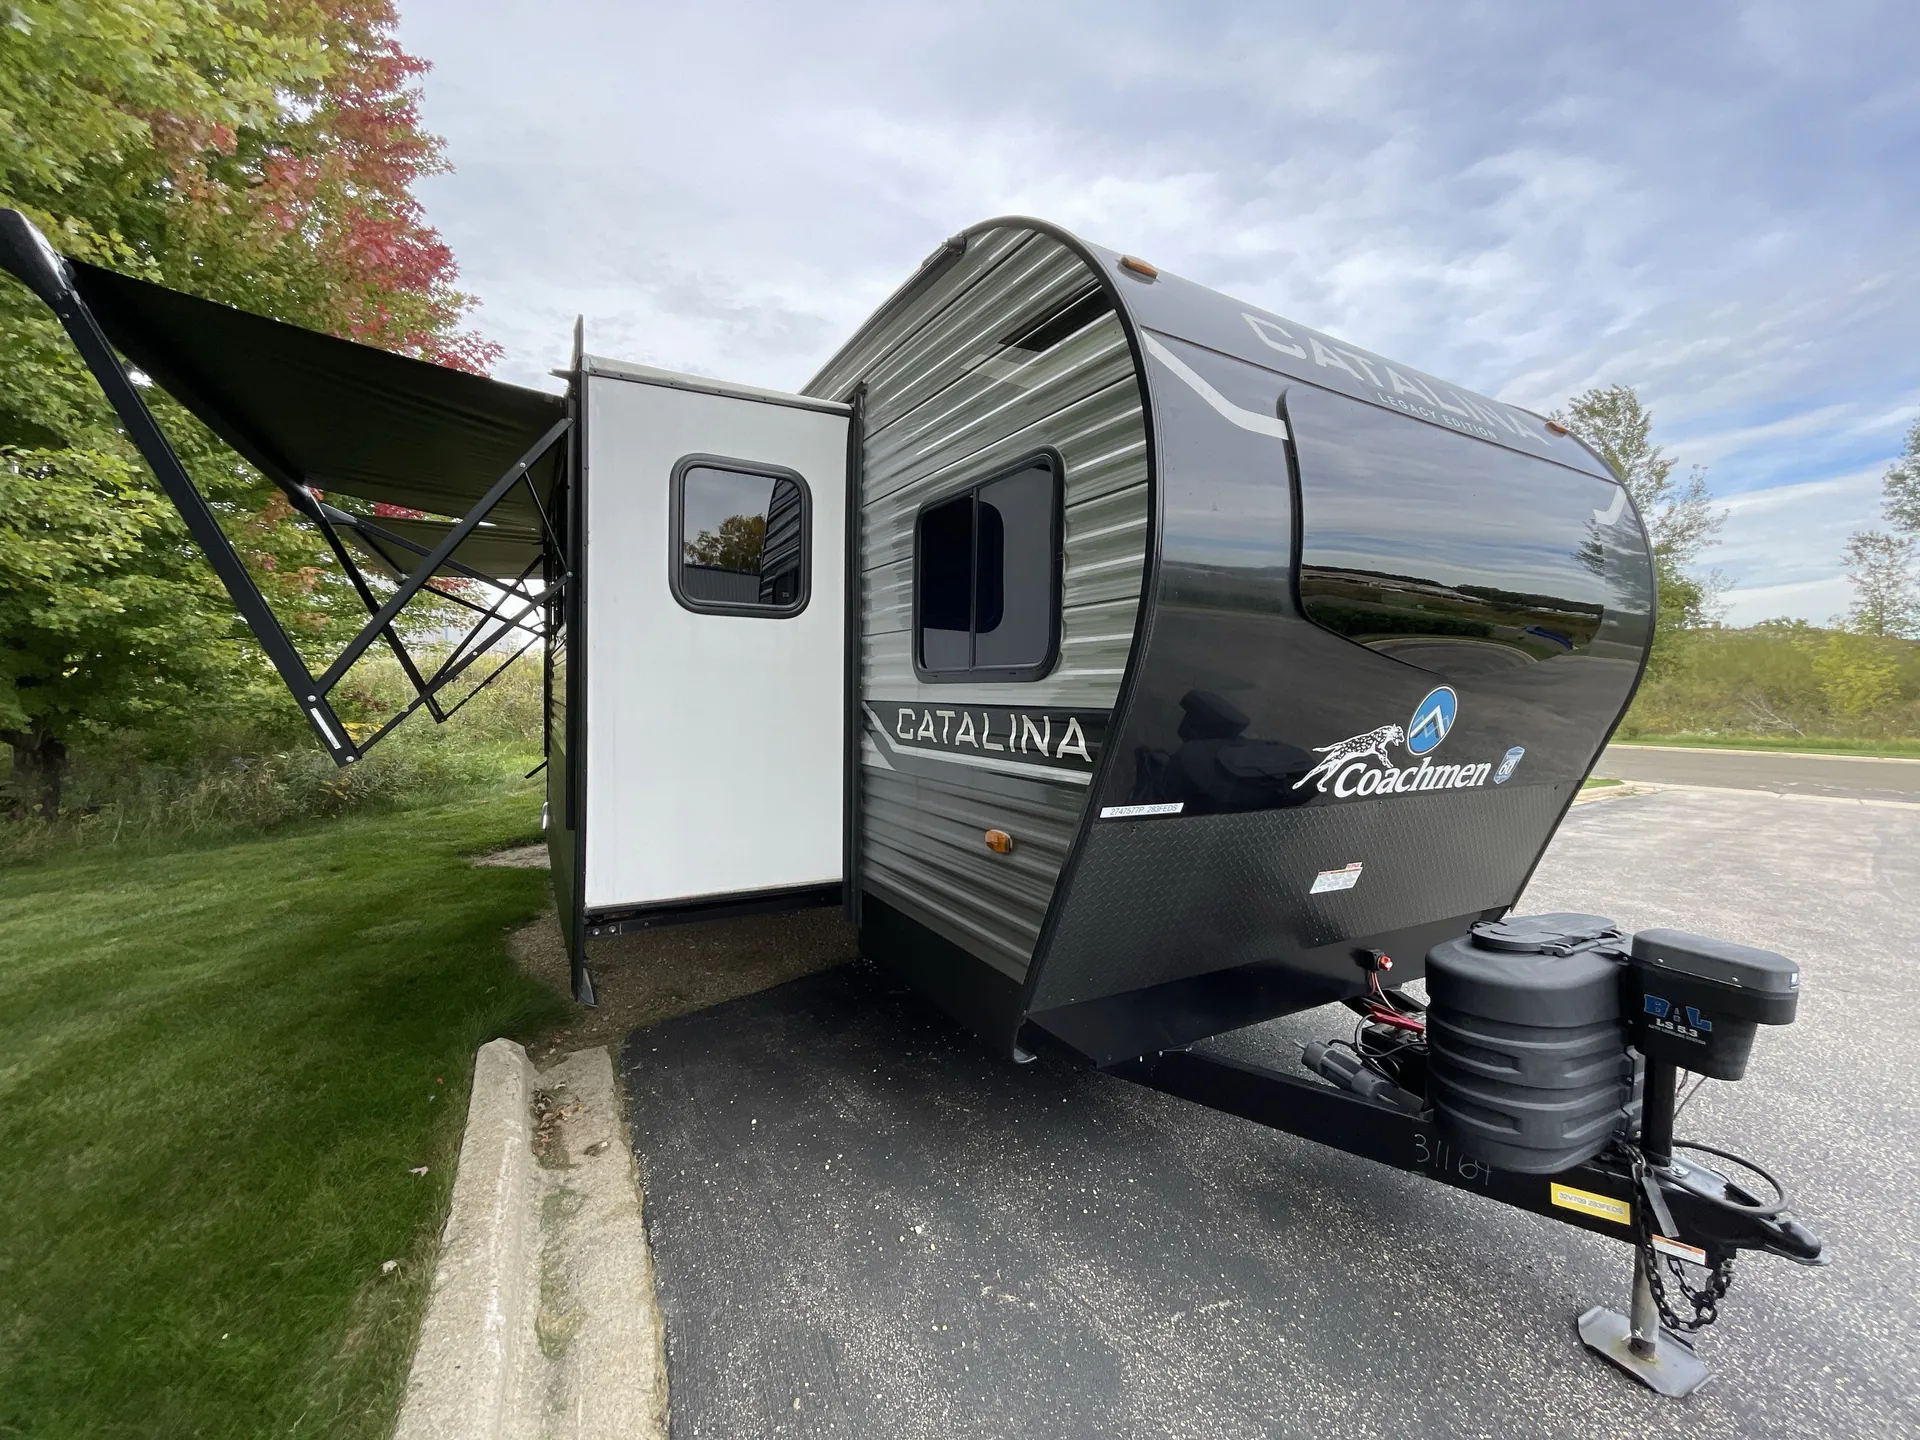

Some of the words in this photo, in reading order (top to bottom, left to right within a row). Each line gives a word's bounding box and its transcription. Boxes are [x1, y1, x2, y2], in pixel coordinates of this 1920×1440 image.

[1242, 312, 1552, 447] CATALINA
[1377, 391, 1437, 420] LEGACY
[1441, 414, 1498, 440] EDITION
[897, 708, 1092, 762] CATALINA
[1334, 756, 1492, 798] Coachmen
[1656, 1018, 1674, 1030] LS
